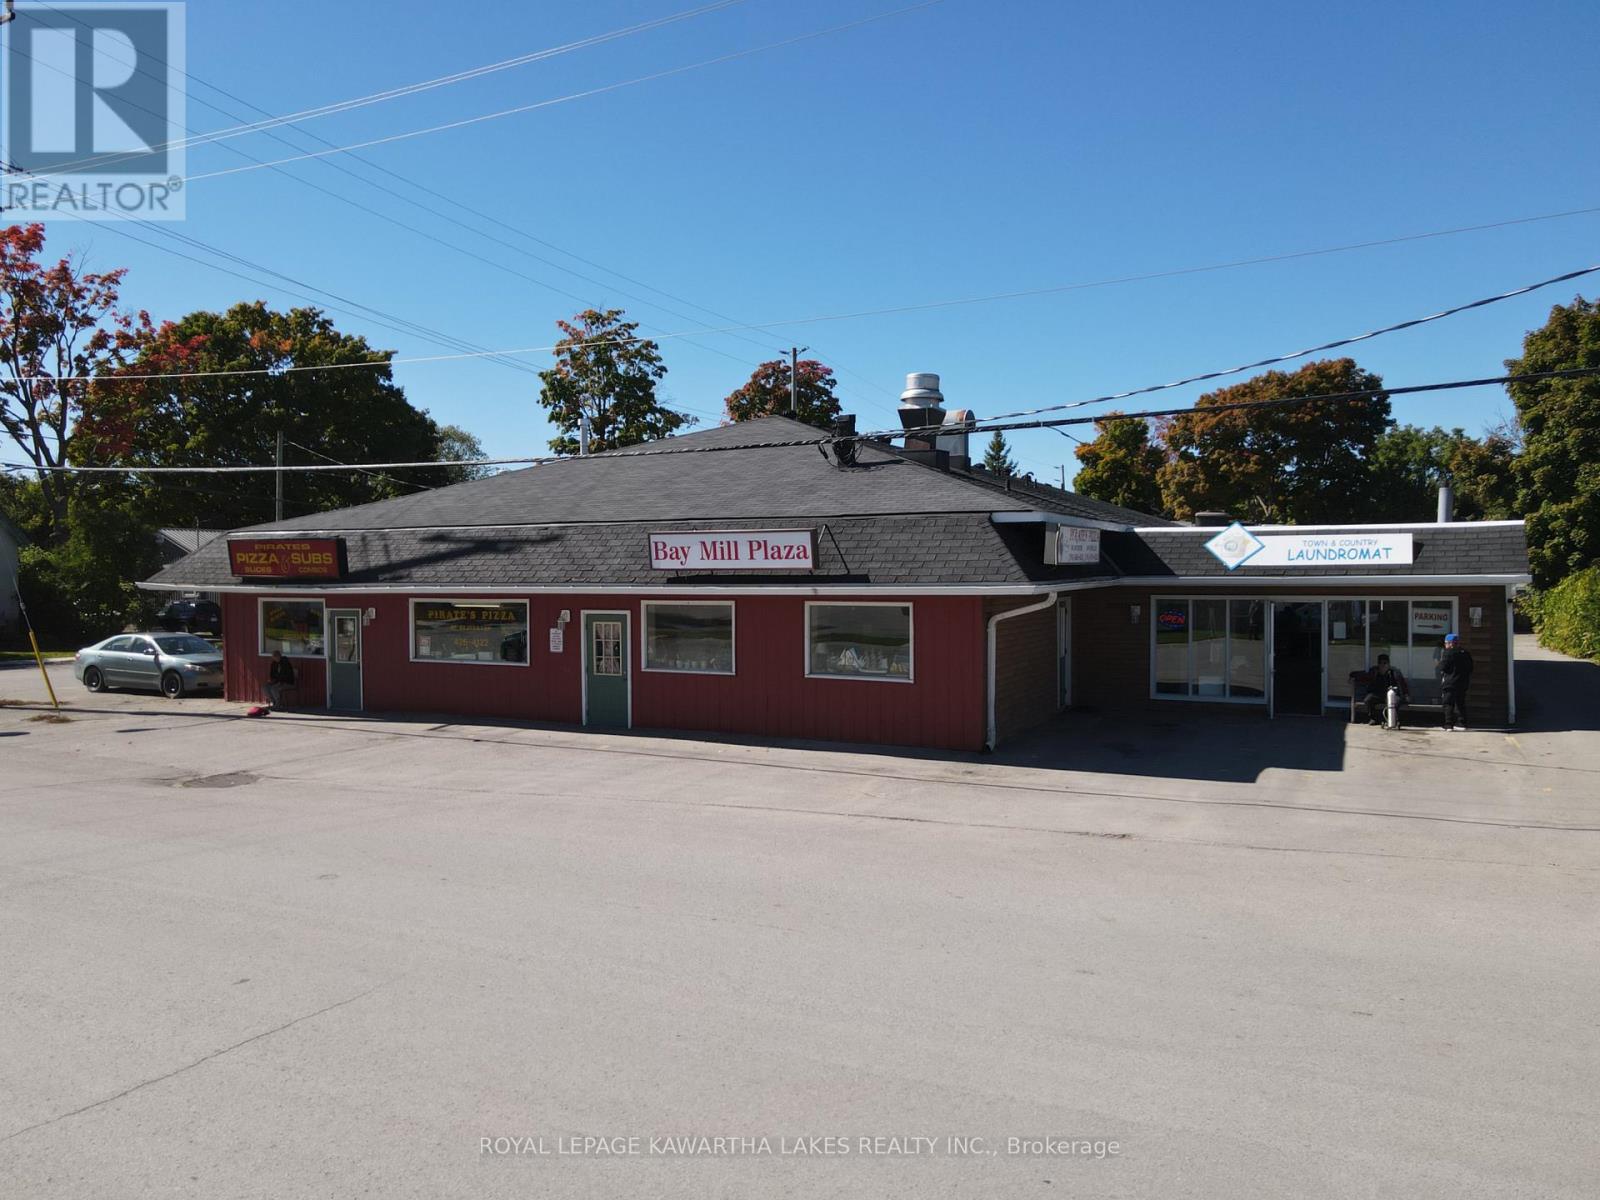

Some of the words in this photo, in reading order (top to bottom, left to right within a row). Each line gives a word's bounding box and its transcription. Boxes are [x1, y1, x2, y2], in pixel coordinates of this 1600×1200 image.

[1303, 539, 1328, 547] TOWN
[1331, 539, 1337, 547] &
[1339, 538, 1378, 546] COUNTRY
[236, 552, 280, 564] PIZZA
[290, 552, 333, 564] SUBS
[653, 541, 691, 565] Bay
[700, 540, 740, 561] Mill
[747, 540, 809, 560] Plaza
[1288, 547, 1392, 561] LAUNDROMAT
[428, 610, 476, 620] PIRATE'S
[481, 611, 516, 620] PIZZA
[1159, 613, 1185, 624] OPEN
[1414, 611, 1448, 622] PARKING
